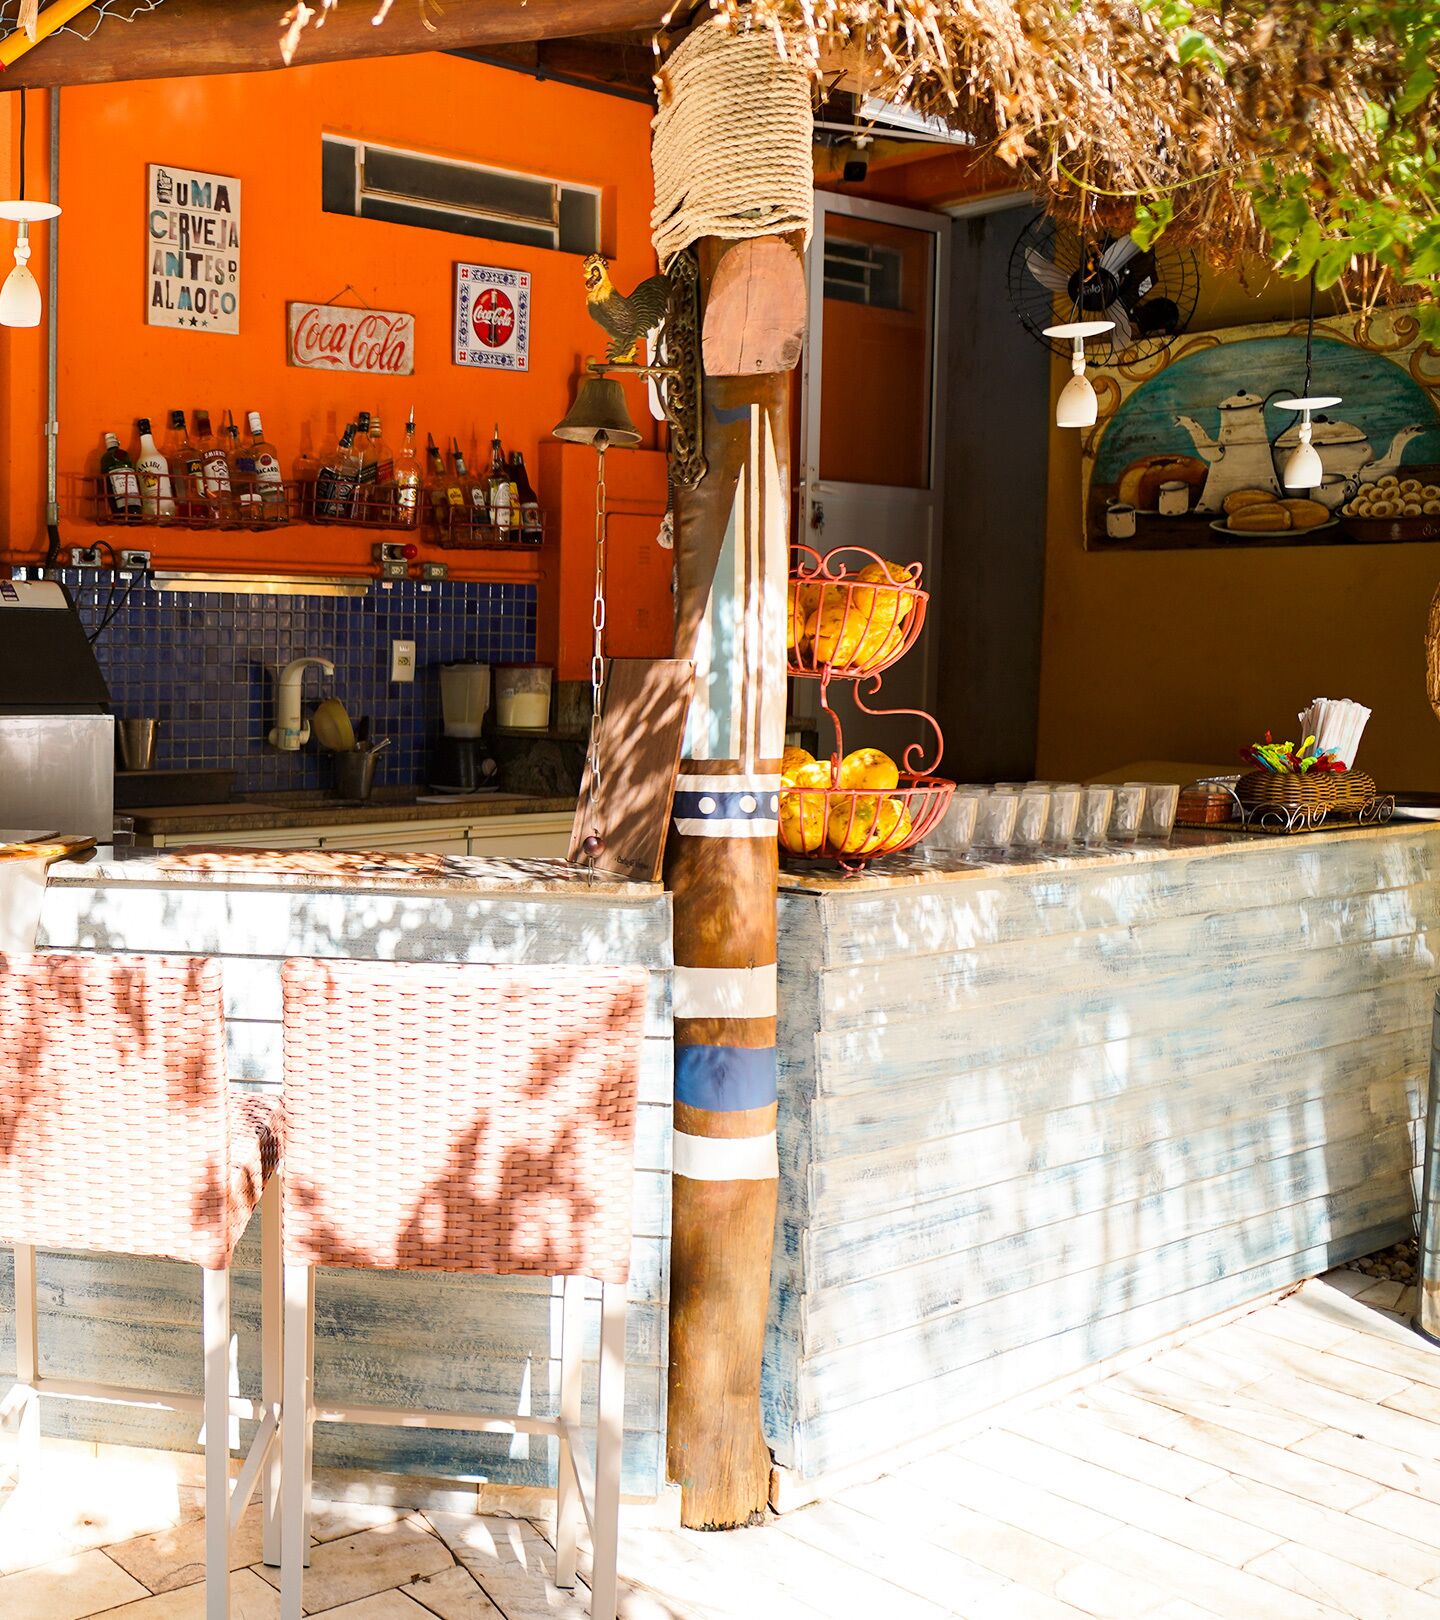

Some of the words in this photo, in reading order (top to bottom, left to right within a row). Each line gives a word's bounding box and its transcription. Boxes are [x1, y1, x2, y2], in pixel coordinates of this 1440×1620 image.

[176, 179, 231, 213] UMA
[149, 209, 239, 250] CERVEJA
[152, 249, 225, 285] ANTES
[151, 279, 237, 319] ALMOÇO
